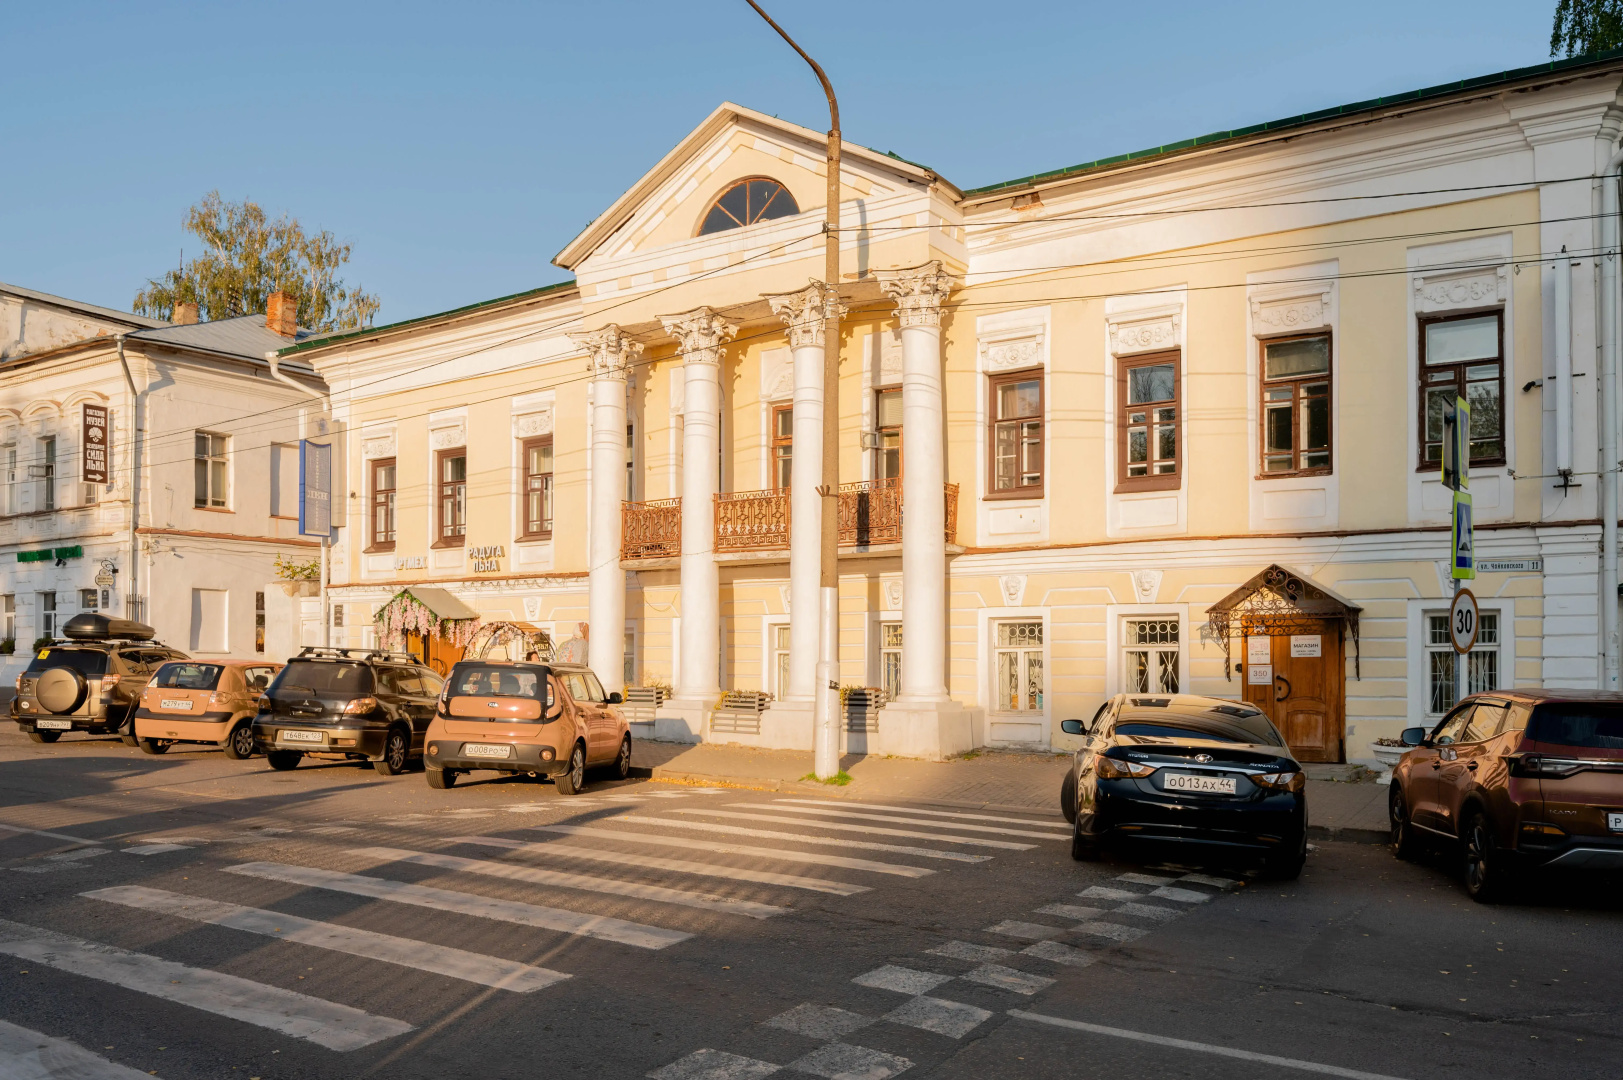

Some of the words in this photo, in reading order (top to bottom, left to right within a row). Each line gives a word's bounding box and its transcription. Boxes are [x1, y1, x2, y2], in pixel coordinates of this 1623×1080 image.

[86, 449, 105, 461] СИЛА
[86, 460, 105, 472] ЛЬНА
[468, 545, 504, 560] РАДУГА
[474, 559, 499, 573] ЛЬНА
[1531, 561, 1538, 570] 11
[1457, 609, 1472, 634] 30
[1169, 776, 1217, 790] О013АХ
[1219, 779, 1231, 789] 44
